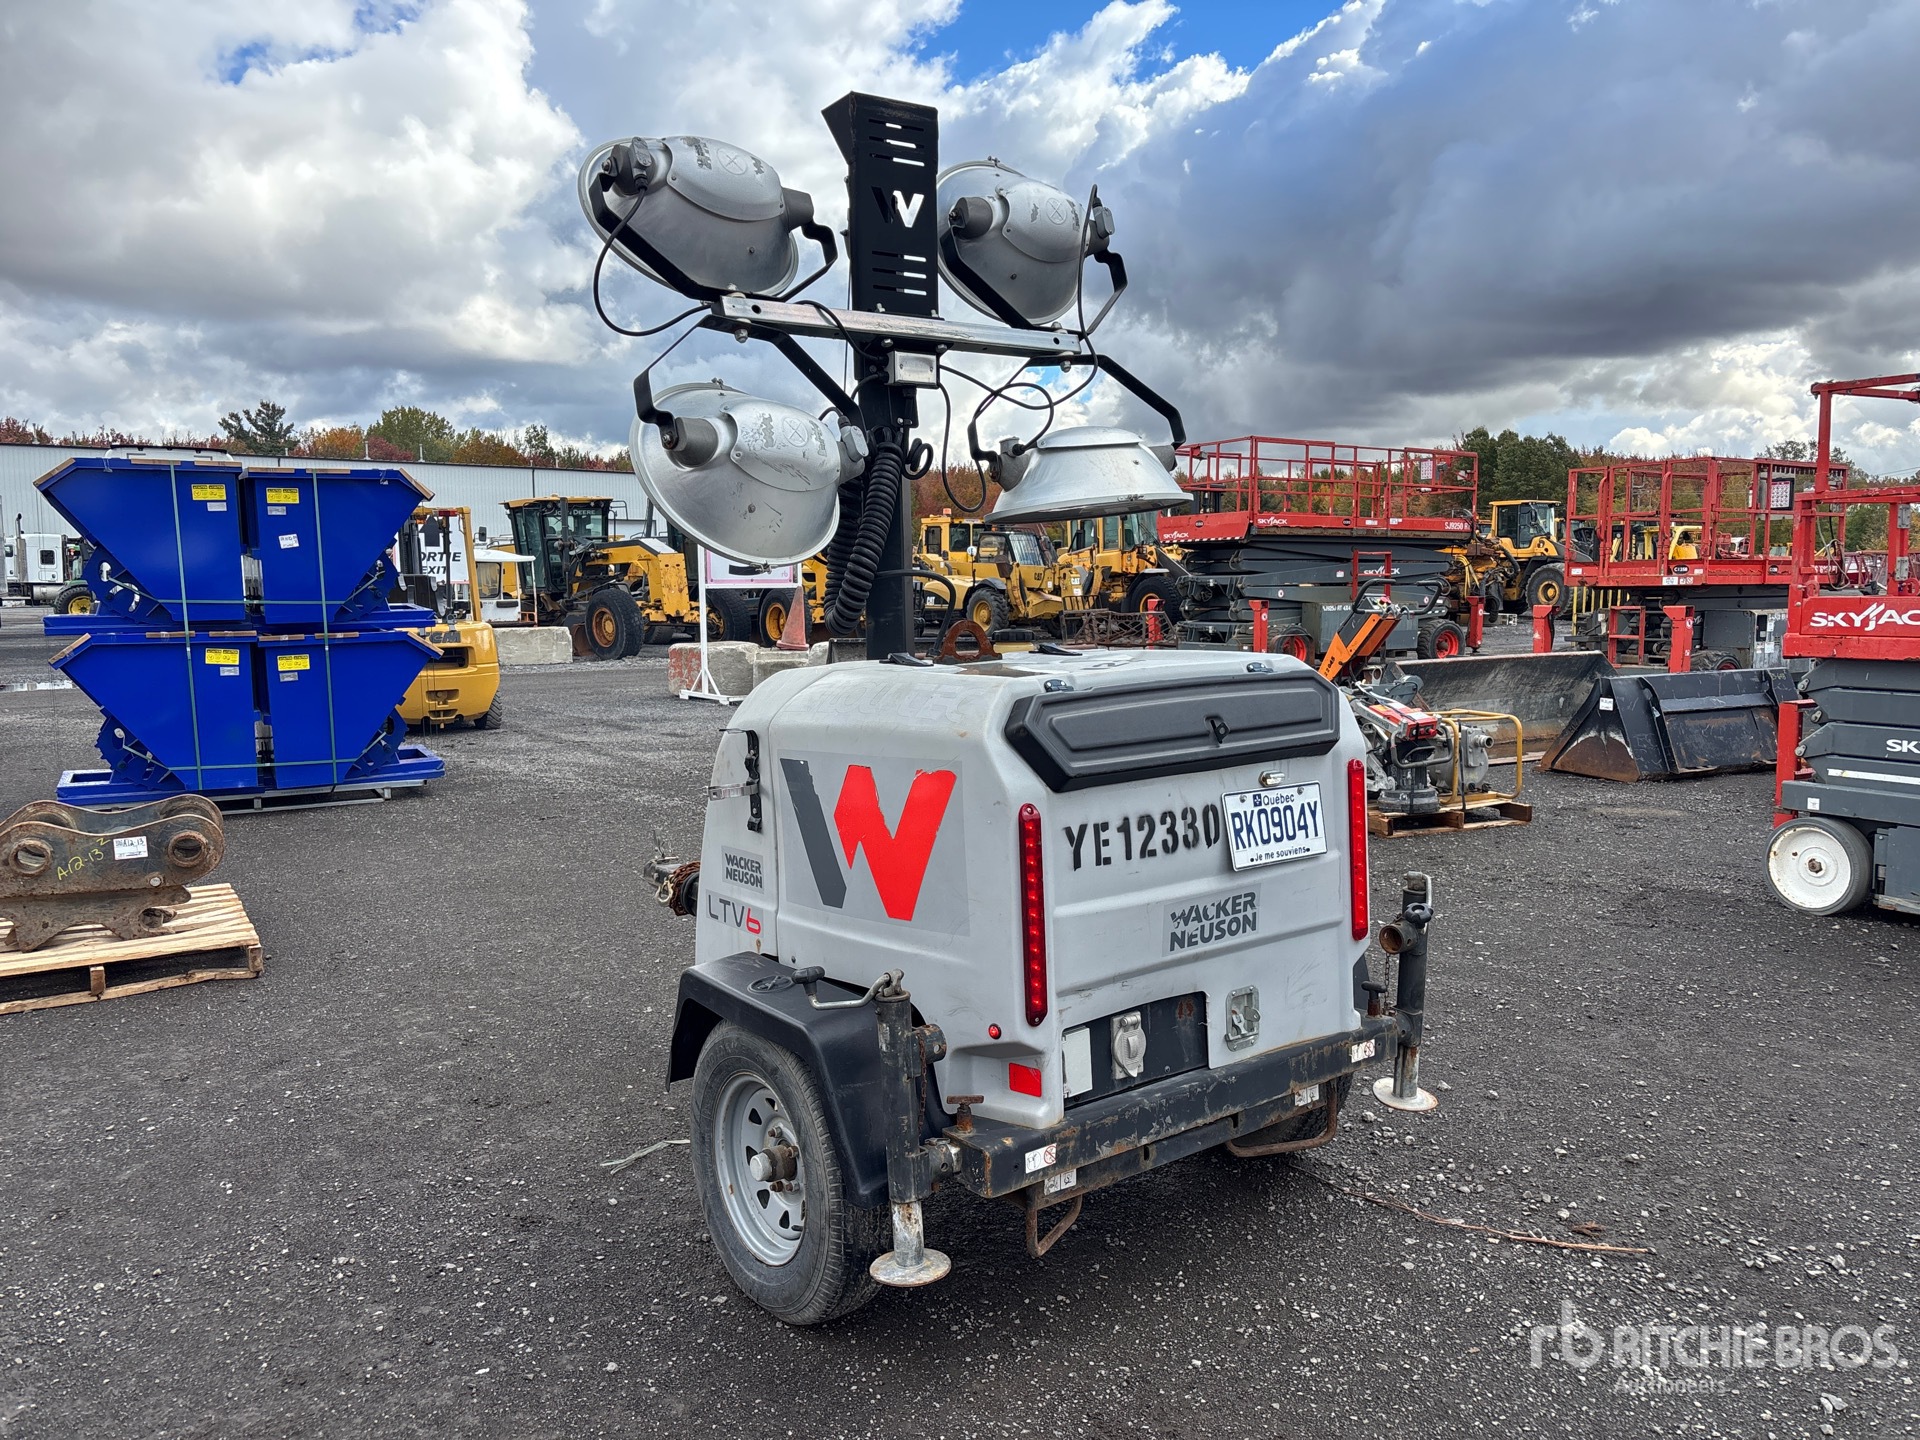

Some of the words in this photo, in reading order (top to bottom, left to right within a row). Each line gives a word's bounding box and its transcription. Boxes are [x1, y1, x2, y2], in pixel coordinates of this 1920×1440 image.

[1257, 516, 1288, 525] SKYJACK
[1163, 531, 1189, 539] SKYJACK
[421, 551, 461, 562] ORTE
[1886, 739, 1920, 753] SK
[1262, 793, 1295, 806] Québec
[1230, 800, 1318, 851] RK0904Y
[1063, 803, 1221, 872] YE12330
[725, 853, 762, 875] WACKER
[1254, 853, 1263, 862] Je
[1264, 852, 1275, 860] me
[1276, 846, 1306, 858] souviens
[725, 867, 763, 889] NEUSON
[708, 894, 761, 935] LTV6
[1170, 891, 1257, 930] WACKER
[1169, 912, 1257, 952] NEUSON
